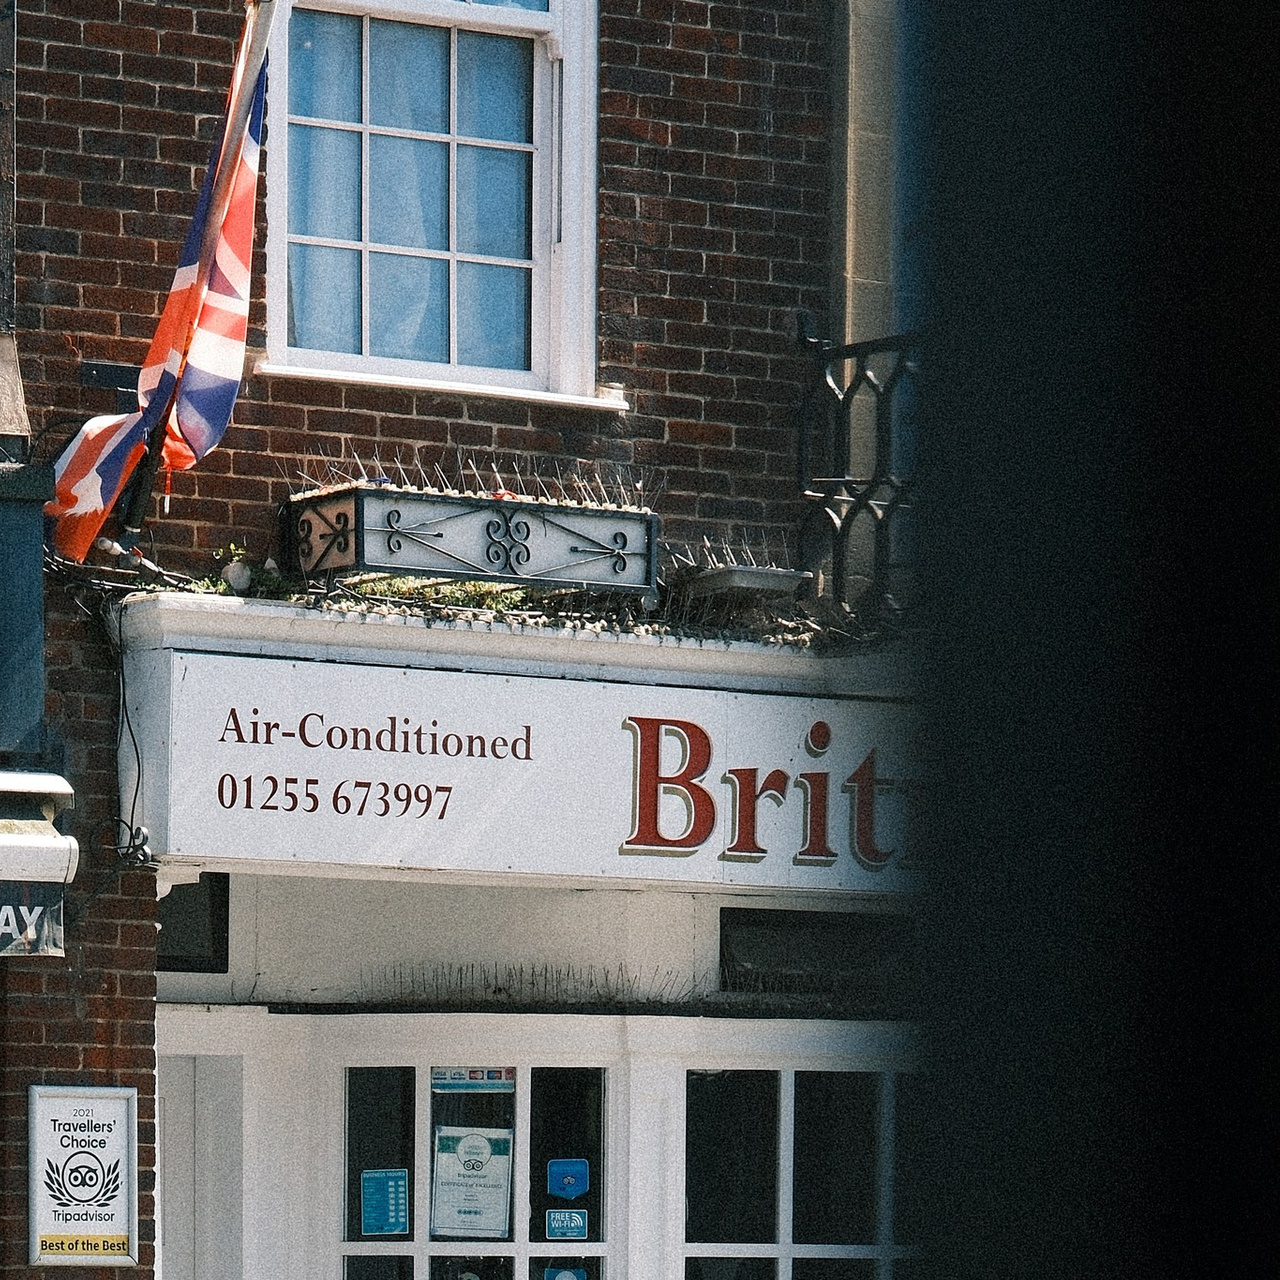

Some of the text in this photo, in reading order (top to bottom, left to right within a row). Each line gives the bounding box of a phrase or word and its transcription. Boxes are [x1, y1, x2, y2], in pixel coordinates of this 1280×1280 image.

[218, 707, 534, 762] Air-Conditioned
[217, 773, 454, 821] 01255 673997
[621, 716, 903, 871] Brit
[73, 1108, 94, 1118] 2021
[50, 1119, 117, 1133] Travellers'
[60, 1135, 107, 1149] Choice
[52, 1209, 116, 1224] Tripadvisor
[550, 1212, 571, 1221] FREE
[551, 1220, 571, 1228] WI-FI
[40, 1239, 127, 1252] Best of the Best
